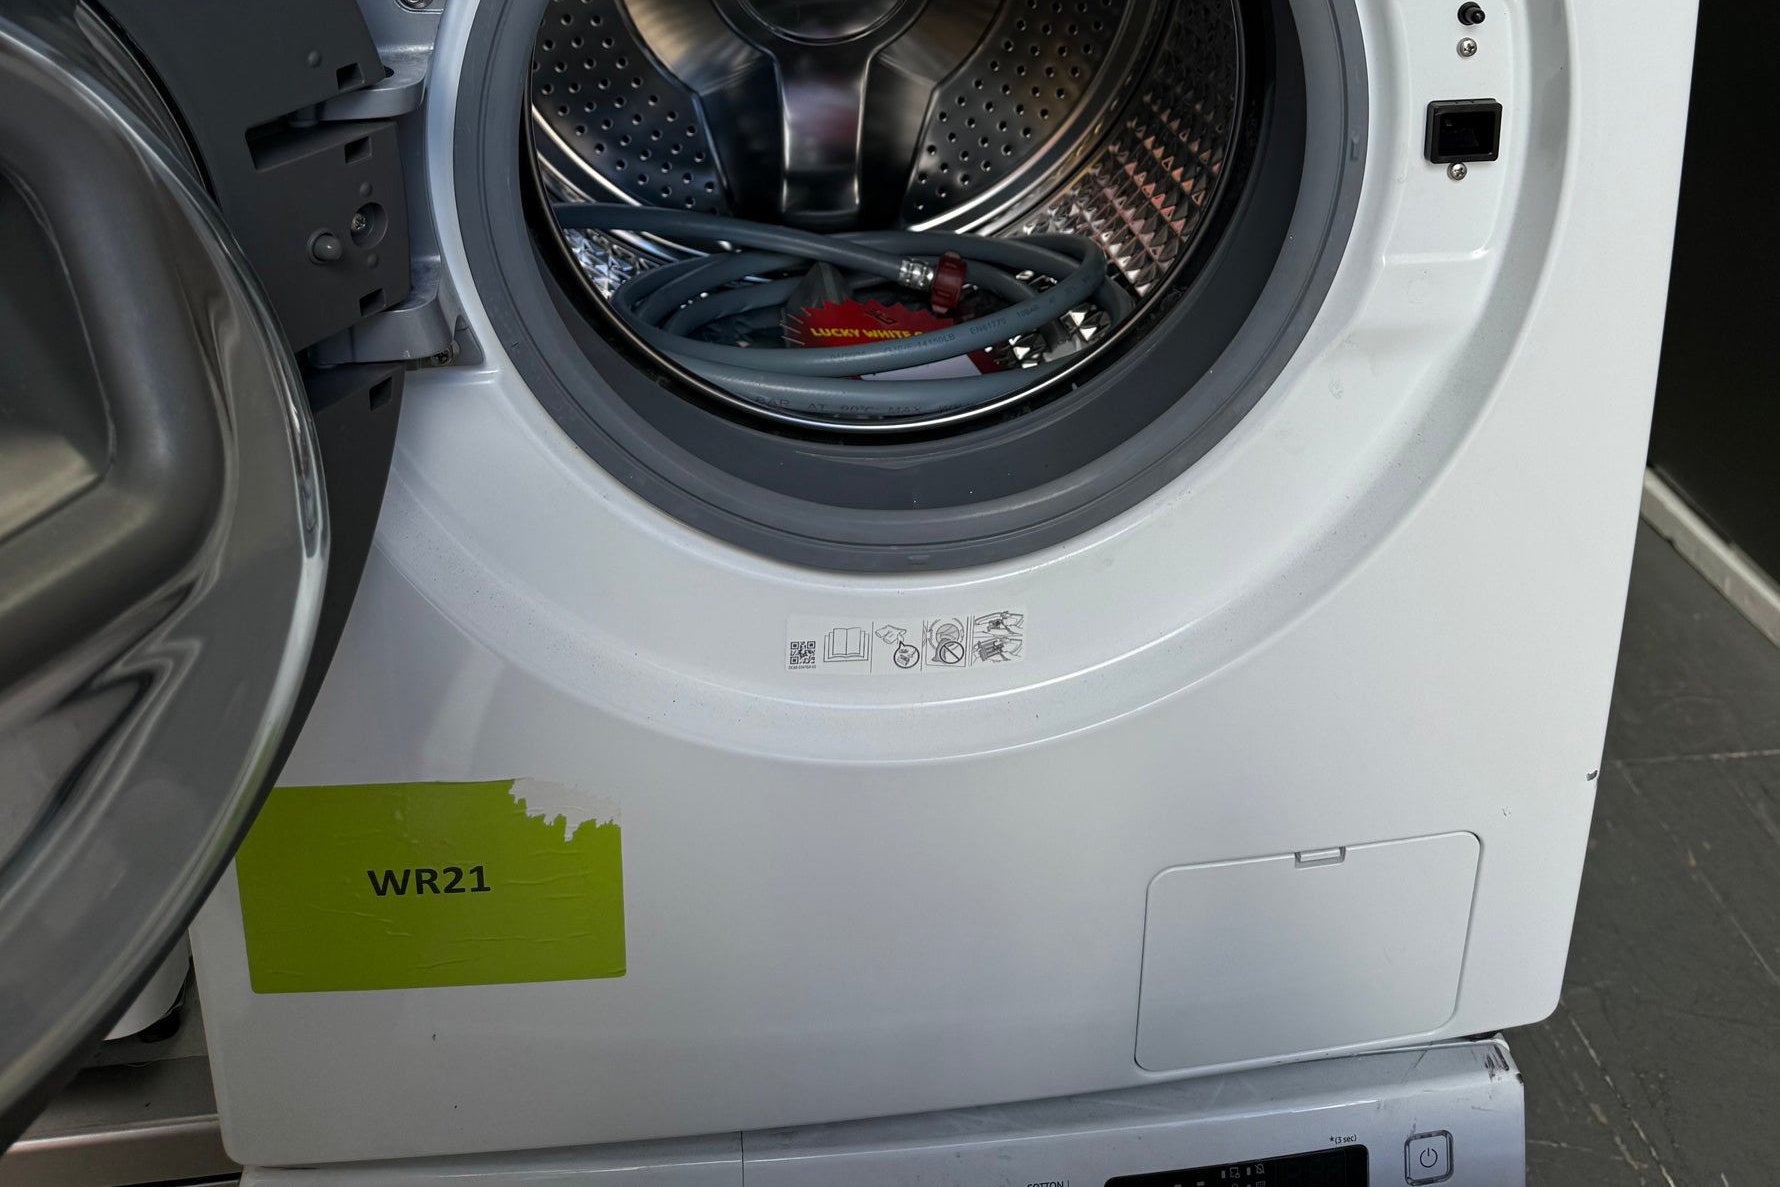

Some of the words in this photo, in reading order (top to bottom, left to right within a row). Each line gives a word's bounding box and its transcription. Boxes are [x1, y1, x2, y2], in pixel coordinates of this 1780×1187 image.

[810, 327, 860, 337] LUCKY
[862, 329, 910, 339] WHITE
[366, 865, 491, 897] WR21
